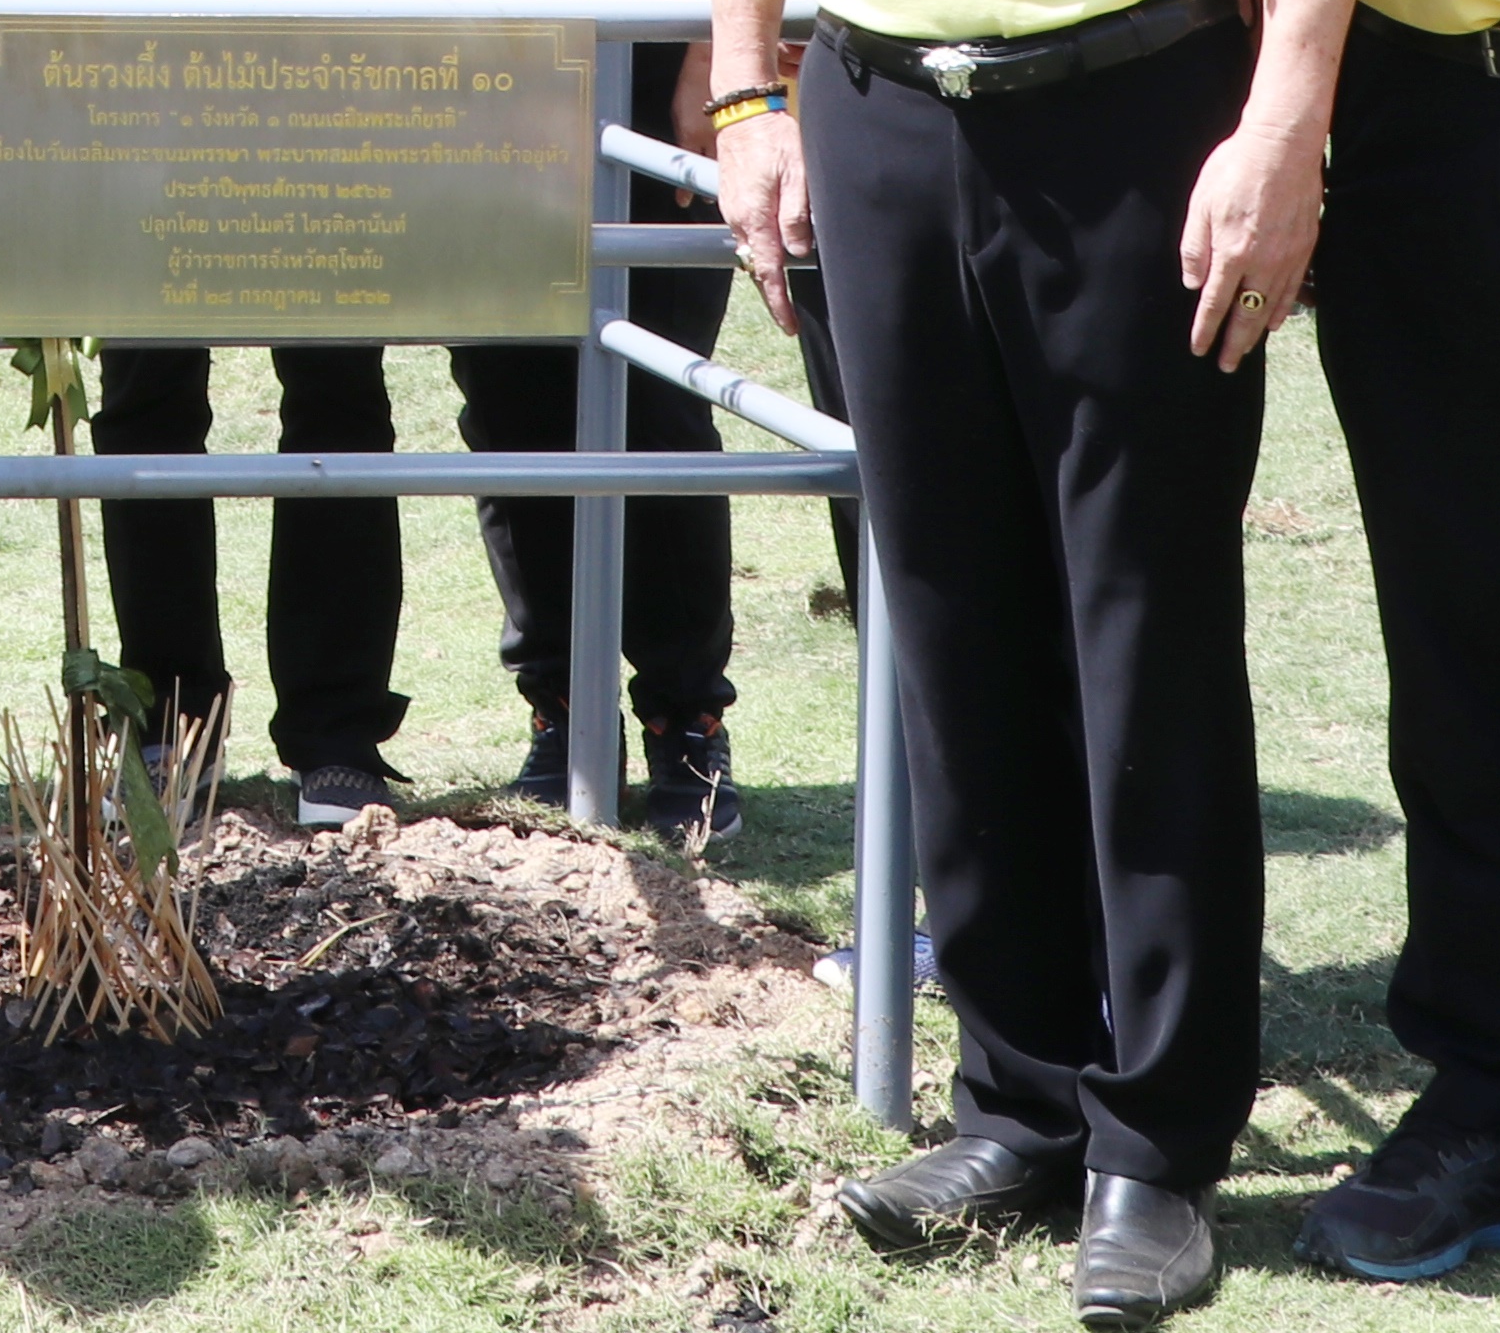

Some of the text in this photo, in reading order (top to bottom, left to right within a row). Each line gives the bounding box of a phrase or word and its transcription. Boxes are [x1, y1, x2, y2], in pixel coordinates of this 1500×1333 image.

[43, 41, 514, 91] ต้นรวงผึ้ง ต้นไม้ประจำรัชกาลที่ ๑๐
[87, 104, 160, 127] โครงการ
[201, 106, 258, 127] จังหวัด
[140, 212, 209, 241] ปลูกโดย
[168, 247, 383, 277] ผู้ว่าราชการจังหวัดสุโขทัย
[160, 279, 197, 305] วันที่
[240, 287, 321, 310] กรกฎาคม
